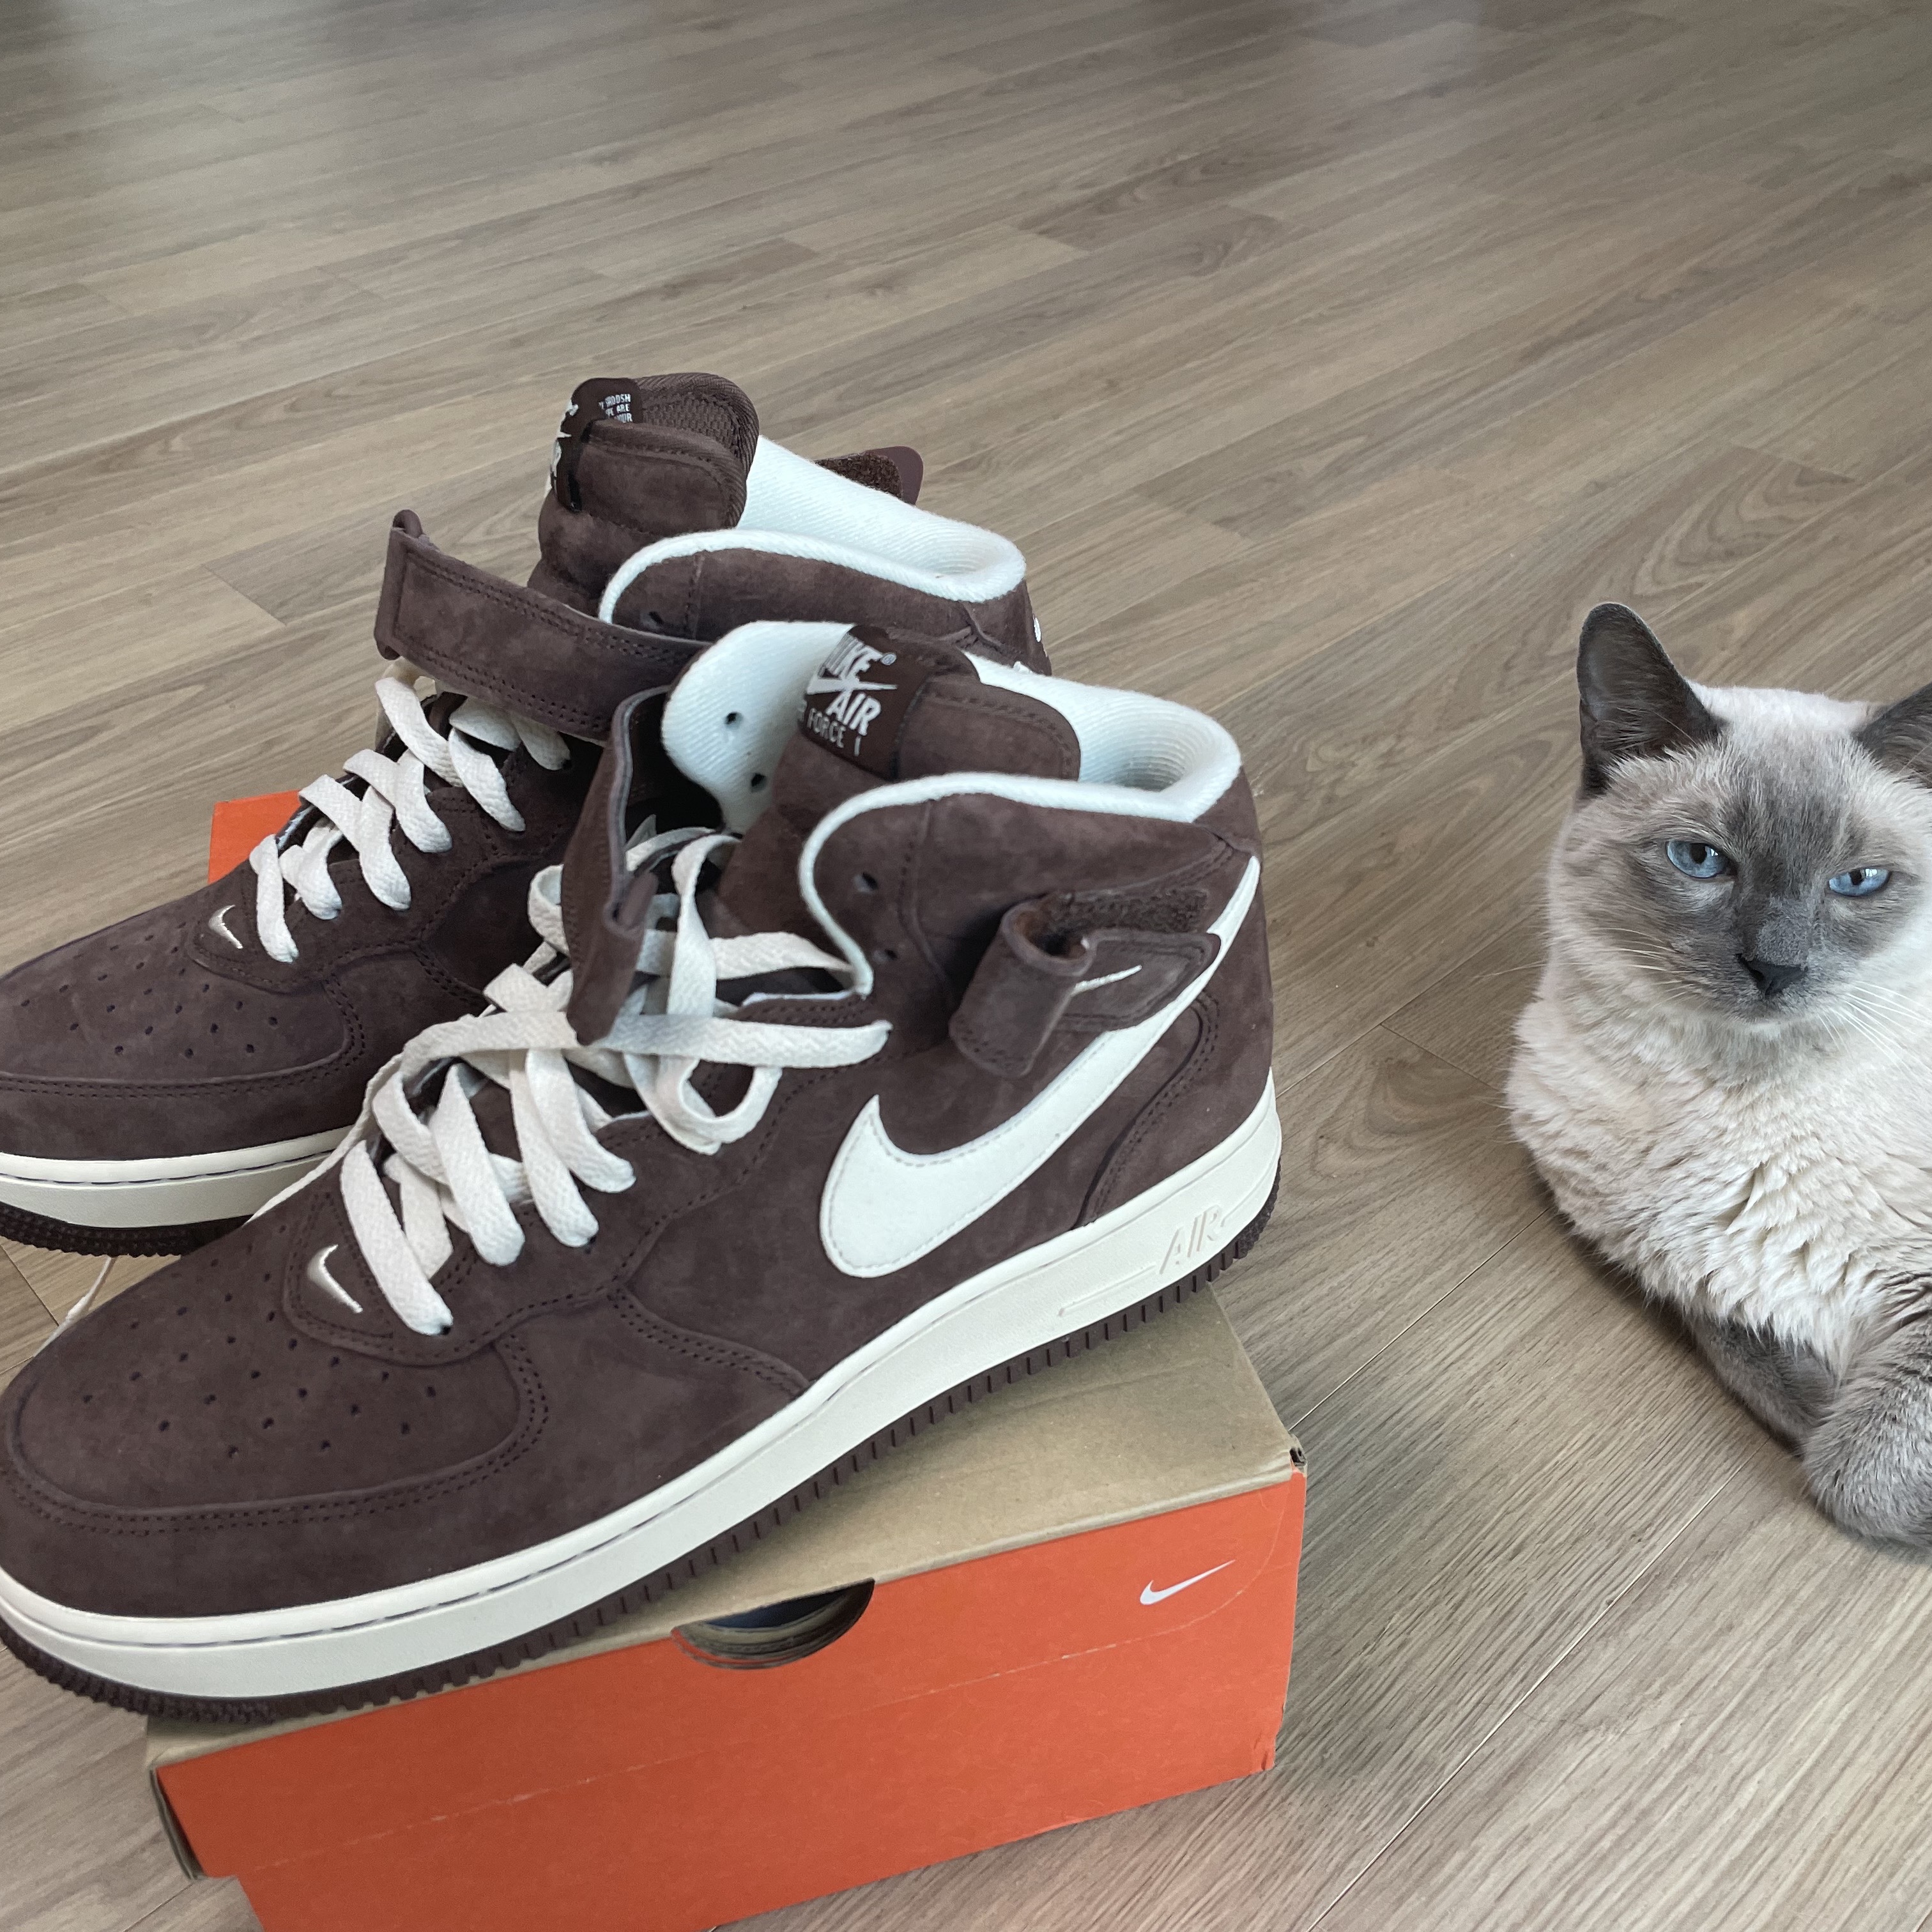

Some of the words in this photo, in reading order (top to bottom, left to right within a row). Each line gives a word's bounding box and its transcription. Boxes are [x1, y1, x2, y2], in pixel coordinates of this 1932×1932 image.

[807, 707, 847, 748] FORCE
[825, 689, 882, 736] AIR
[1159, 1204, 1223, 1275] AIR
